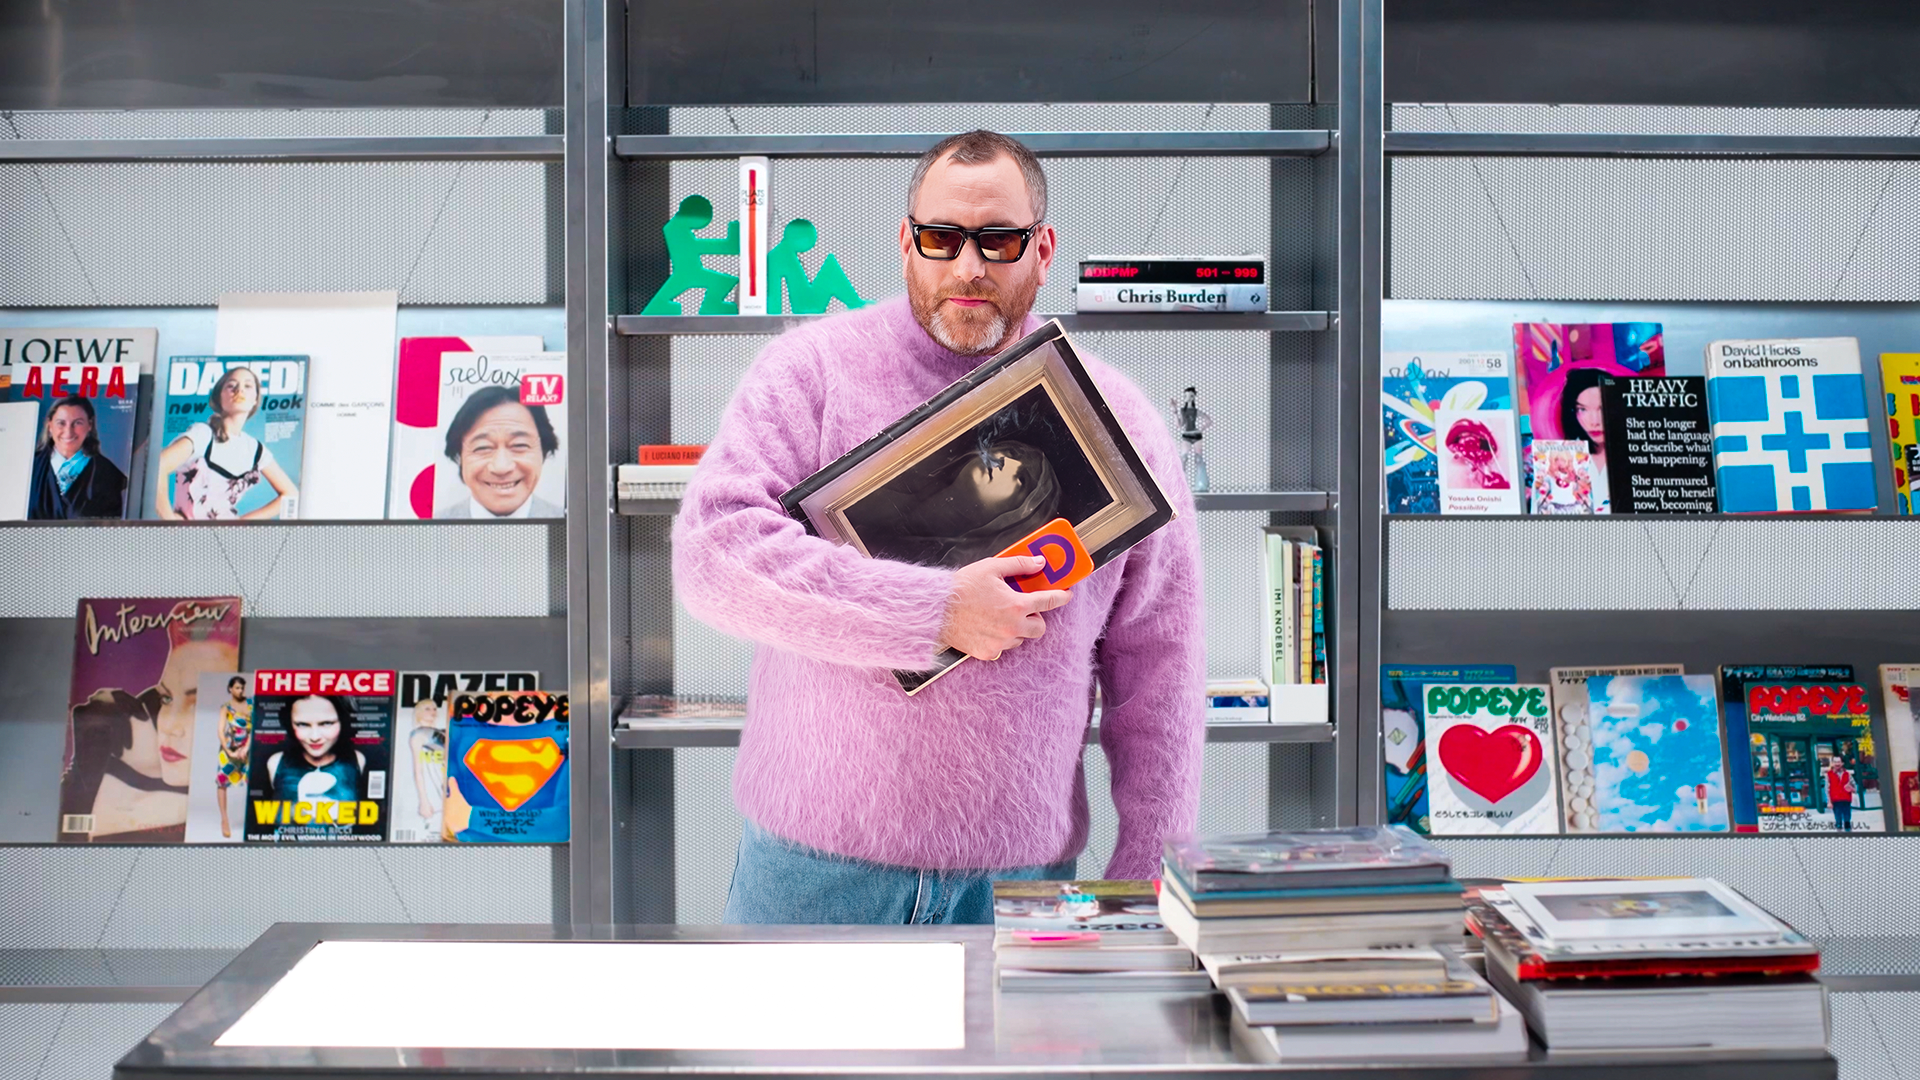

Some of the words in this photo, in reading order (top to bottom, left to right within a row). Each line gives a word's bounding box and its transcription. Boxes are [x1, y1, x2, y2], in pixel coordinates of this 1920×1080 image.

[1196, 268, 1218, 278] 501
[1234, 268, 1258, 278] 999
[1117, 289, 1162, 304] Chris
[1166, 289, 1228, 304] Burden
[1722, 344, 1760, 357] David
[1763, 344, 1801, 356] Hicks
[1486, 358, 1502, 368] 58
[1723, 359, 1741, 369] on
[1743, 357, 1818, 369] bathrooms
[169, 360, 299, 395] DAED
[444, 355, 524, 386] relax
[23, 366, 127, 398] AERA
[527, 377, 559, 395] TV
[1629, 379, 1688, 393] HEAVY
[261, 395, 302, 411] look
[526, 394, 558, 403] RELAX?
[1622, 393, 1698, 408] TRAFFIC
[1626, 418, 1646, 428] She
[1663, 418, 1697, 431] longer
[1627, 430, 1647, 440] had
[1649, 430, 1665, 440] the
[1628, 443, 1639, 452] to
[1641, 442, 1684, 452] describe
[1686, 442, 1711, 452] what
[651, 452, 680, 460] LUCIANO
[1629, 456, 1648, 464] was
[1650, 454, 1708, 467] happening.
[1631, 475, 1651, 485] She
[1653, 475, 1708, 485] murmured
[1632, 487, 1665, 500] loudly
[1668, 489, 1678, 498] to
[1681, 487, 1716, 498] herself
[1634, 502, 1659, 511] now,
[1661, 499, 1713, 512] becoming
[1027, 533, 1076, 585] D
[1274, 588, 1282, 605] IMI
[85, 602, 231, 655] Interview
[1274, 610, 1283, 662] KNOEBEL
[258, 673, 311, 692] THE
[319, 673, 391, 692] FACE
[1427, 687, 1548, 717] POPEYE
[1749, 685, 1868, 715] POPEYE
[453, 694, 569, 724] POPEYE
[253, 800, 379, 825] WICKED
[479, 810, 497, 818] Why
[278, 826, 327, 835] CHRISTINA
[328, 826, 353, 835] RICCI
